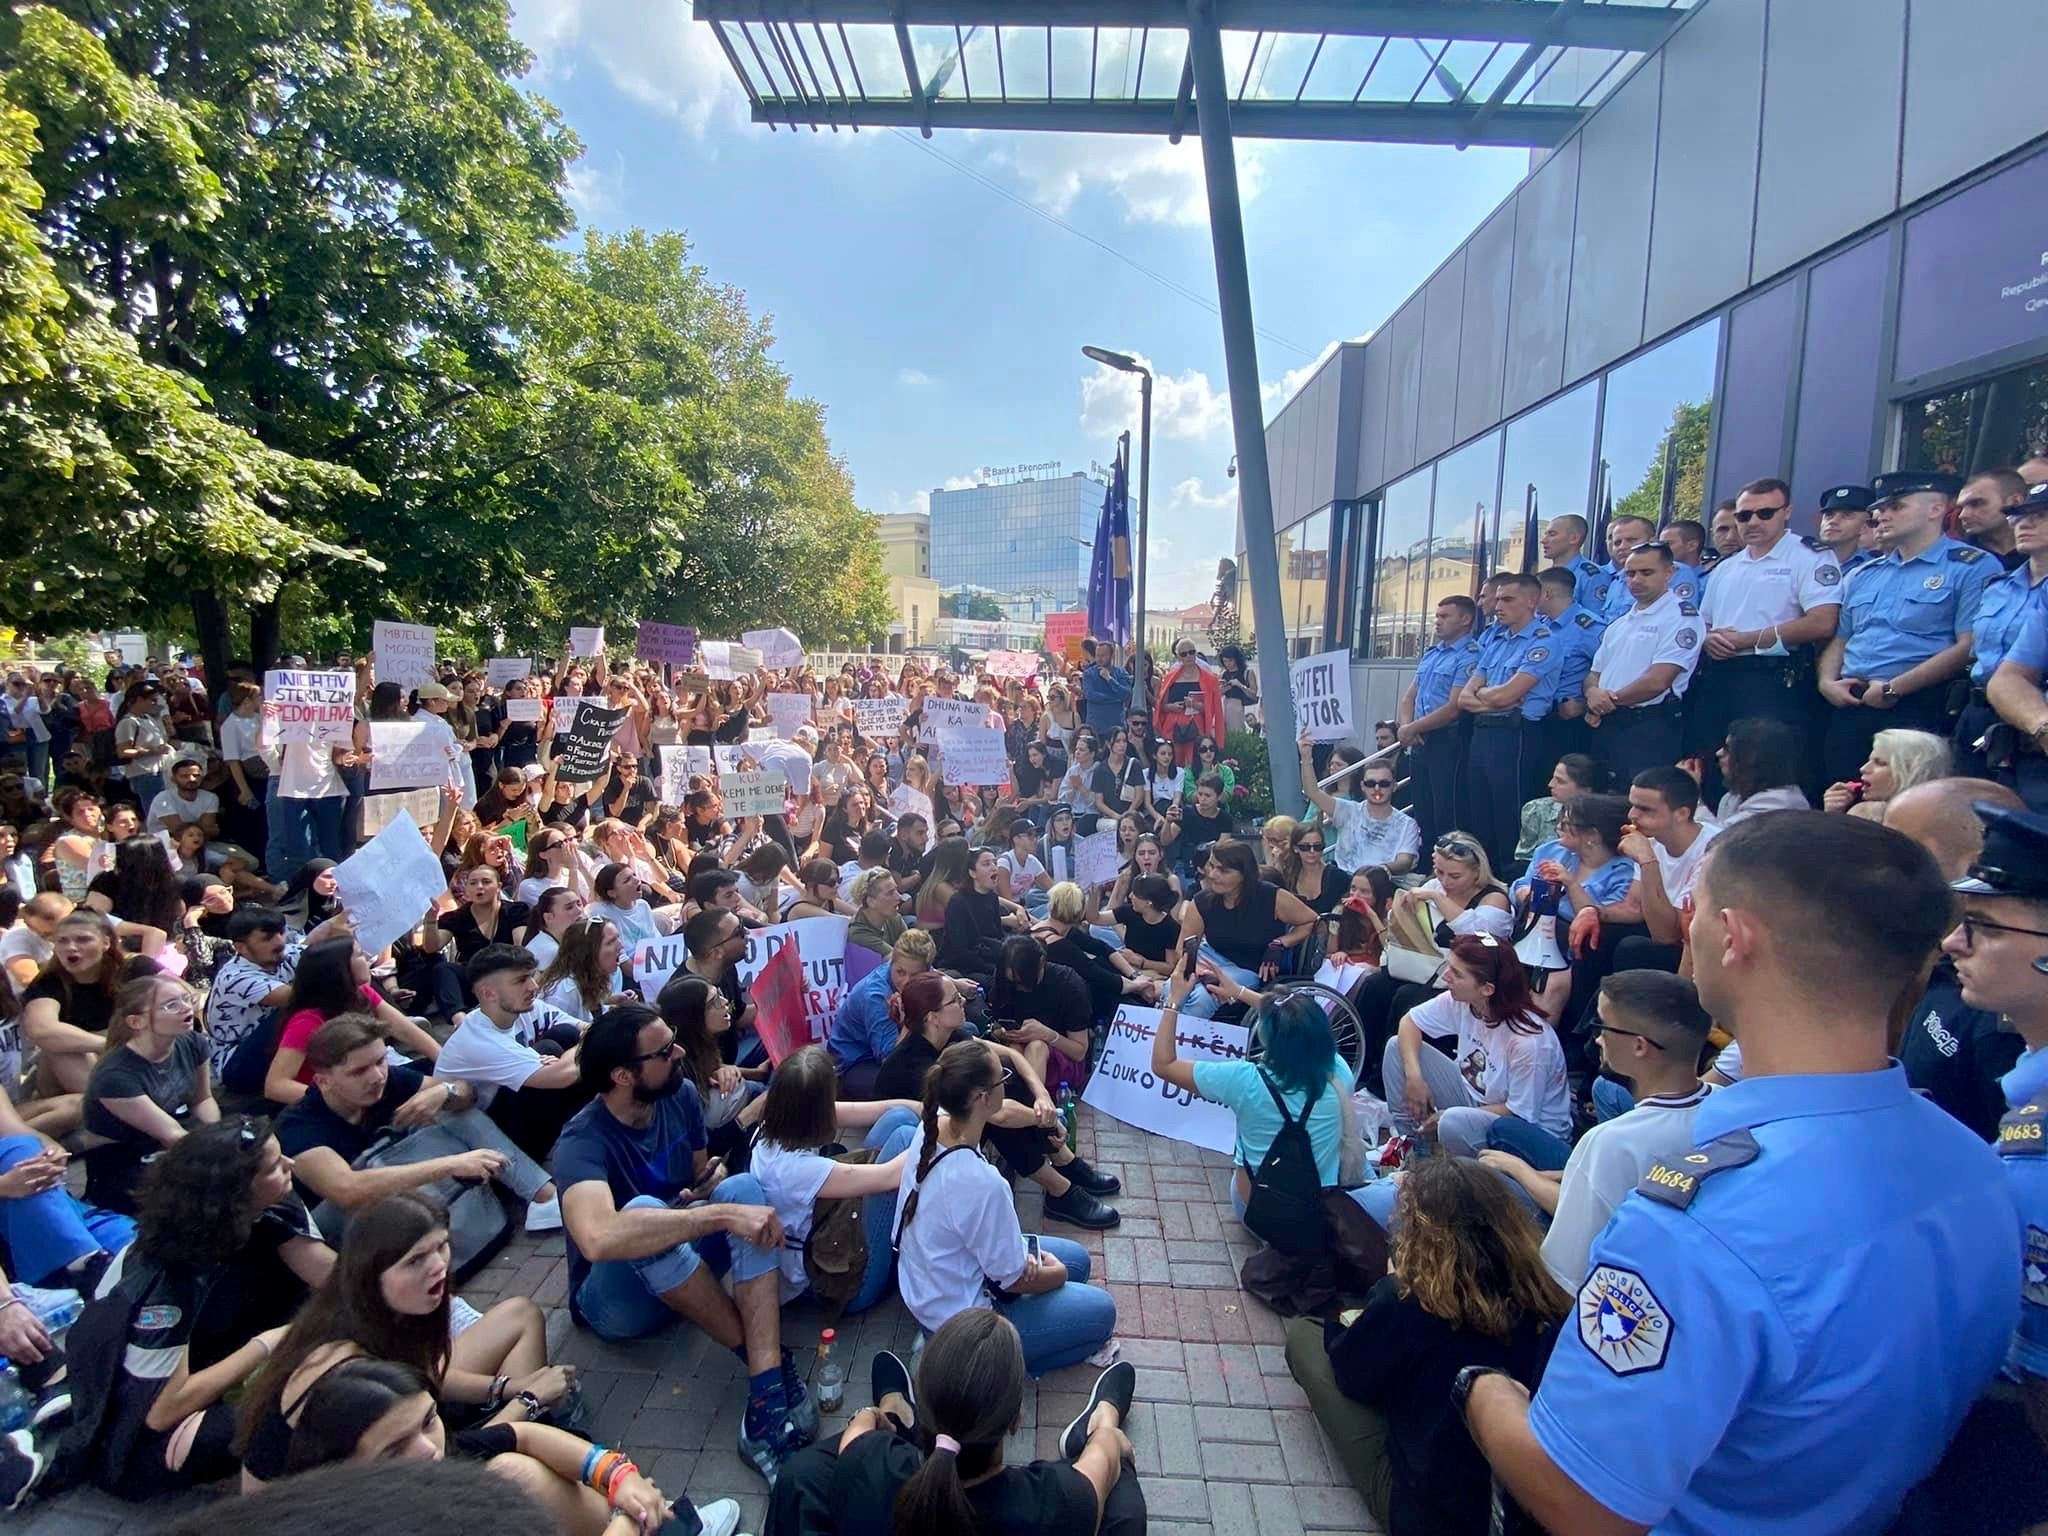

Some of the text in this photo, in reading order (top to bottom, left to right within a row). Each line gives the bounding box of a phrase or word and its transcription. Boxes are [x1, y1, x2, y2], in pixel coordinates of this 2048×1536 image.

[992, 466, 1015, 476] Banka
[279, 672, 348, 688] INICIATIV
[927, 699, 980, 714] DHUNA NUK
[947, 716, 963, 727] KA
[739, 774, 761, 784] KUR
[723, 787, 746, 799] KEMI
[749, 786, 761, 796] ME
[1922, 1010, 1959, 1057] POLICE
[1177, 1031, 1244, 1059] IKËN
[1646, 1164, 1694, 1193] 10684
[1596, 1271, 1663, 1329] KOSOVO
[1607, 1286, 1643, 1319] POLICE
